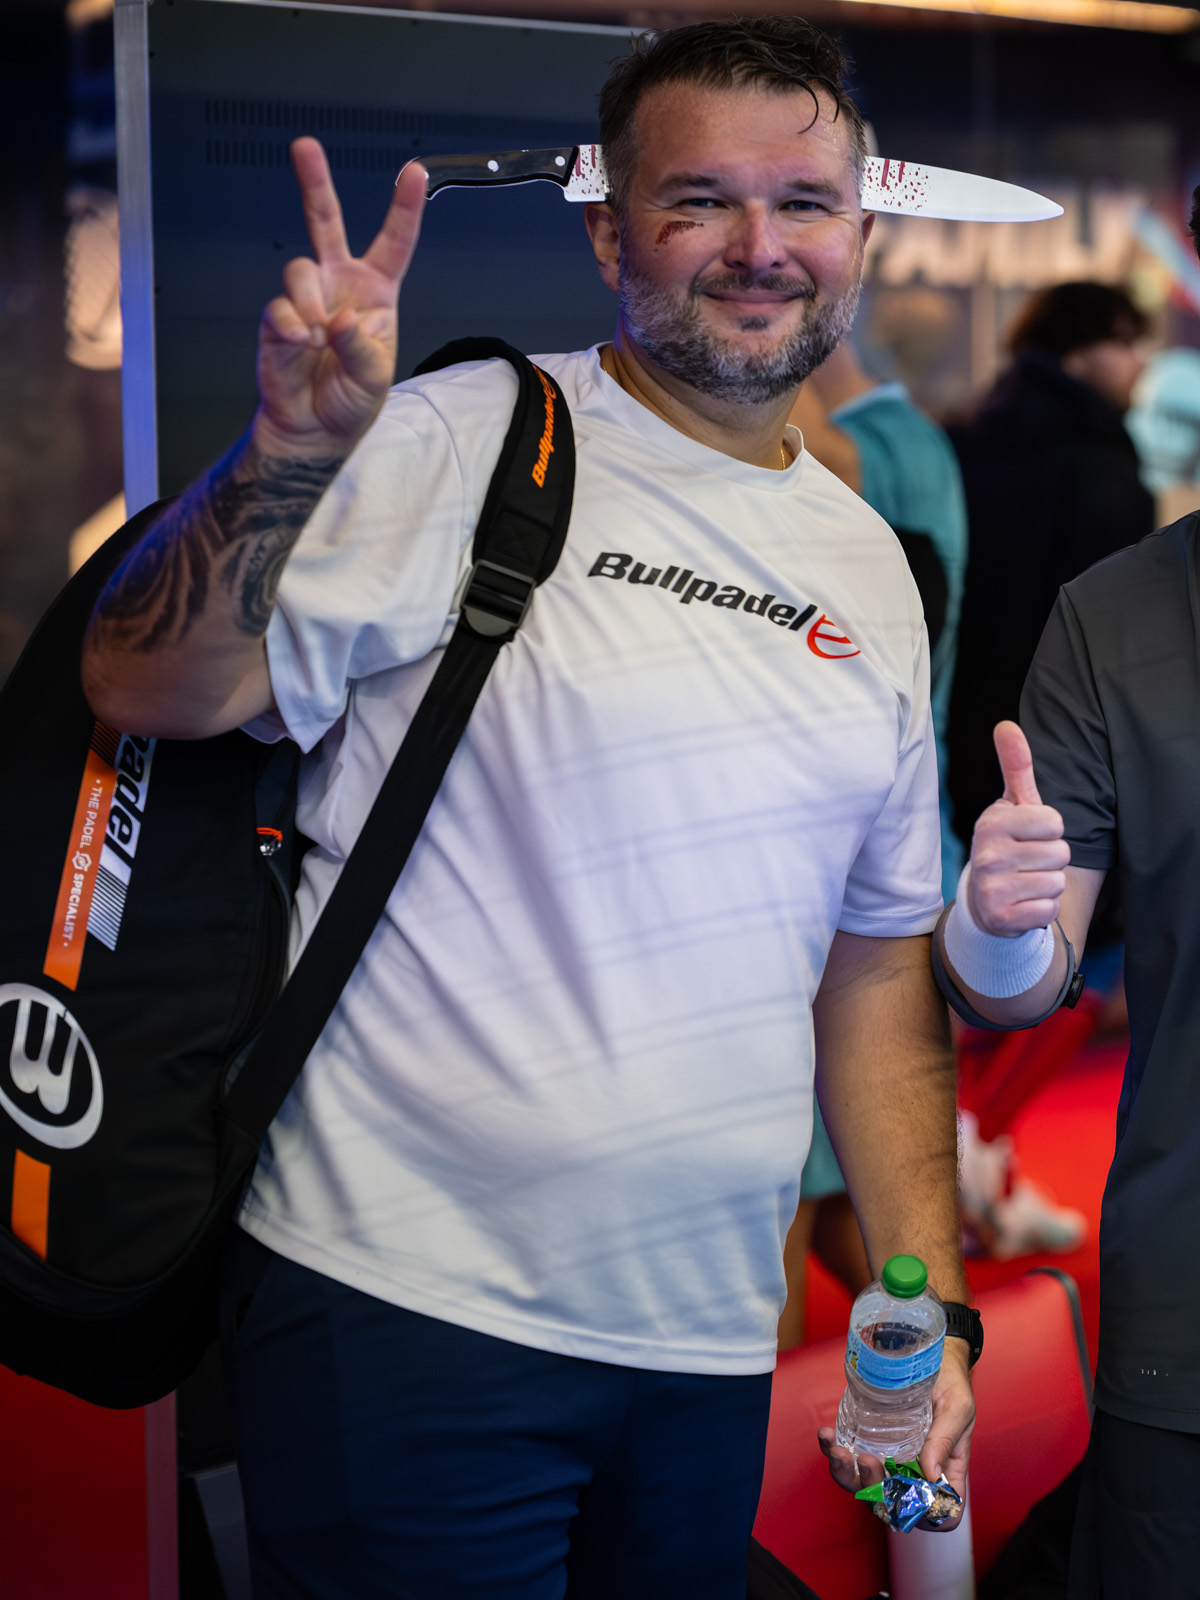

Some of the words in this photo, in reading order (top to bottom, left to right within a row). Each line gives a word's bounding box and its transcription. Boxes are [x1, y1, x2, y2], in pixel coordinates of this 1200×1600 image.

[587, 551, 818, 631] Bullpadel
[87, 785, 103, 810] THE
[79, 810, 97, 849] PADEL
[62, 873, 85, 941] SPECIALIST
